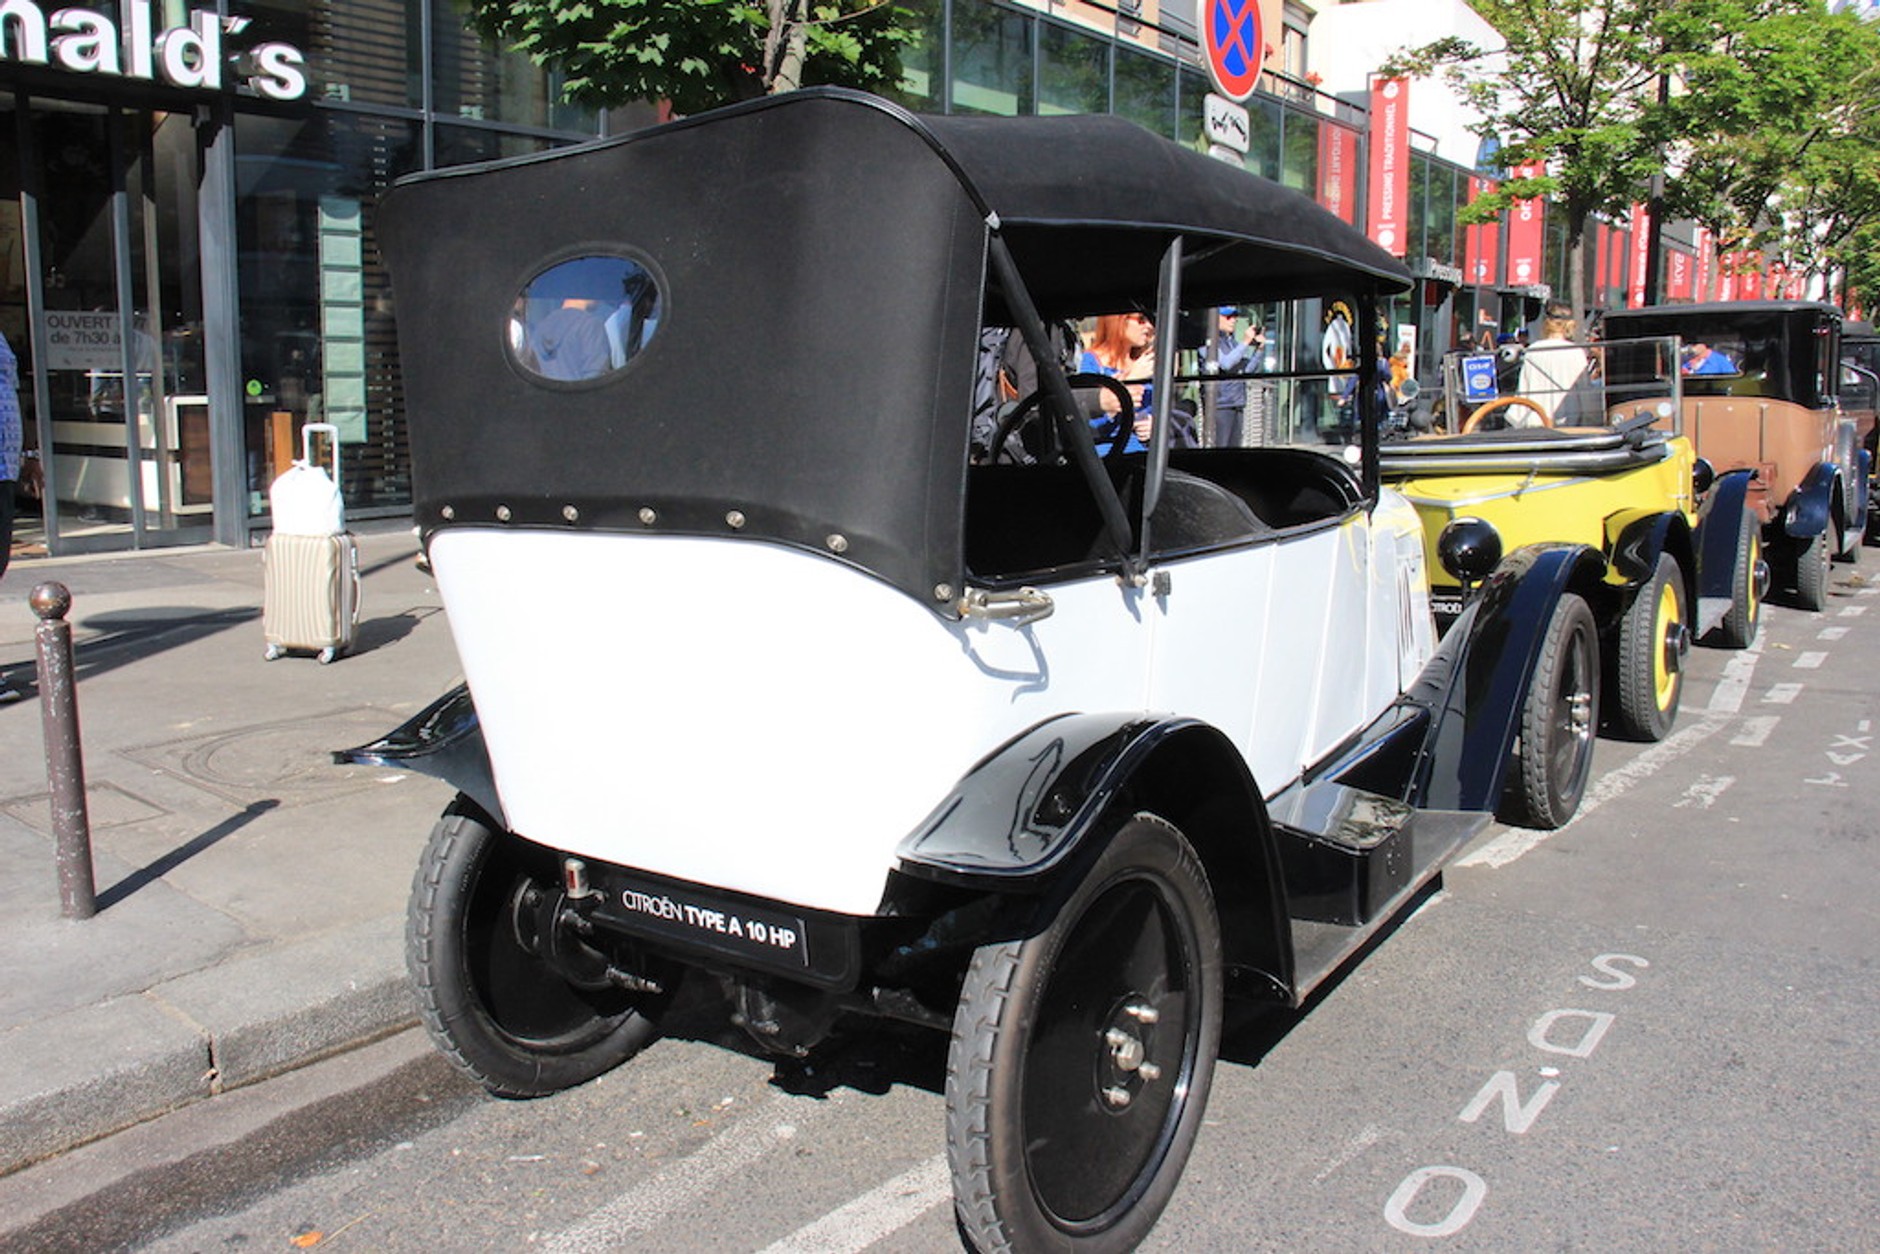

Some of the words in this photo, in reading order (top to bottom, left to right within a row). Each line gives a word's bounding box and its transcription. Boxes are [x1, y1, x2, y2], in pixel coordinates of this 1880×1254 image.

[1383, 102, 1397, 170] TRADITIONNEL
[1381, 172, 1395, 220] PRESSING
[47, 314, 113, 329] OUVERT
[50, 330, 70, 345] de
[73, 330, 110, 345] 7h30
[684, 905, 727, 933] TYPE
[728, 916, 744, 937] A
[746, 921, 768, 942] 10
[769, 925, 797, 949] HP
